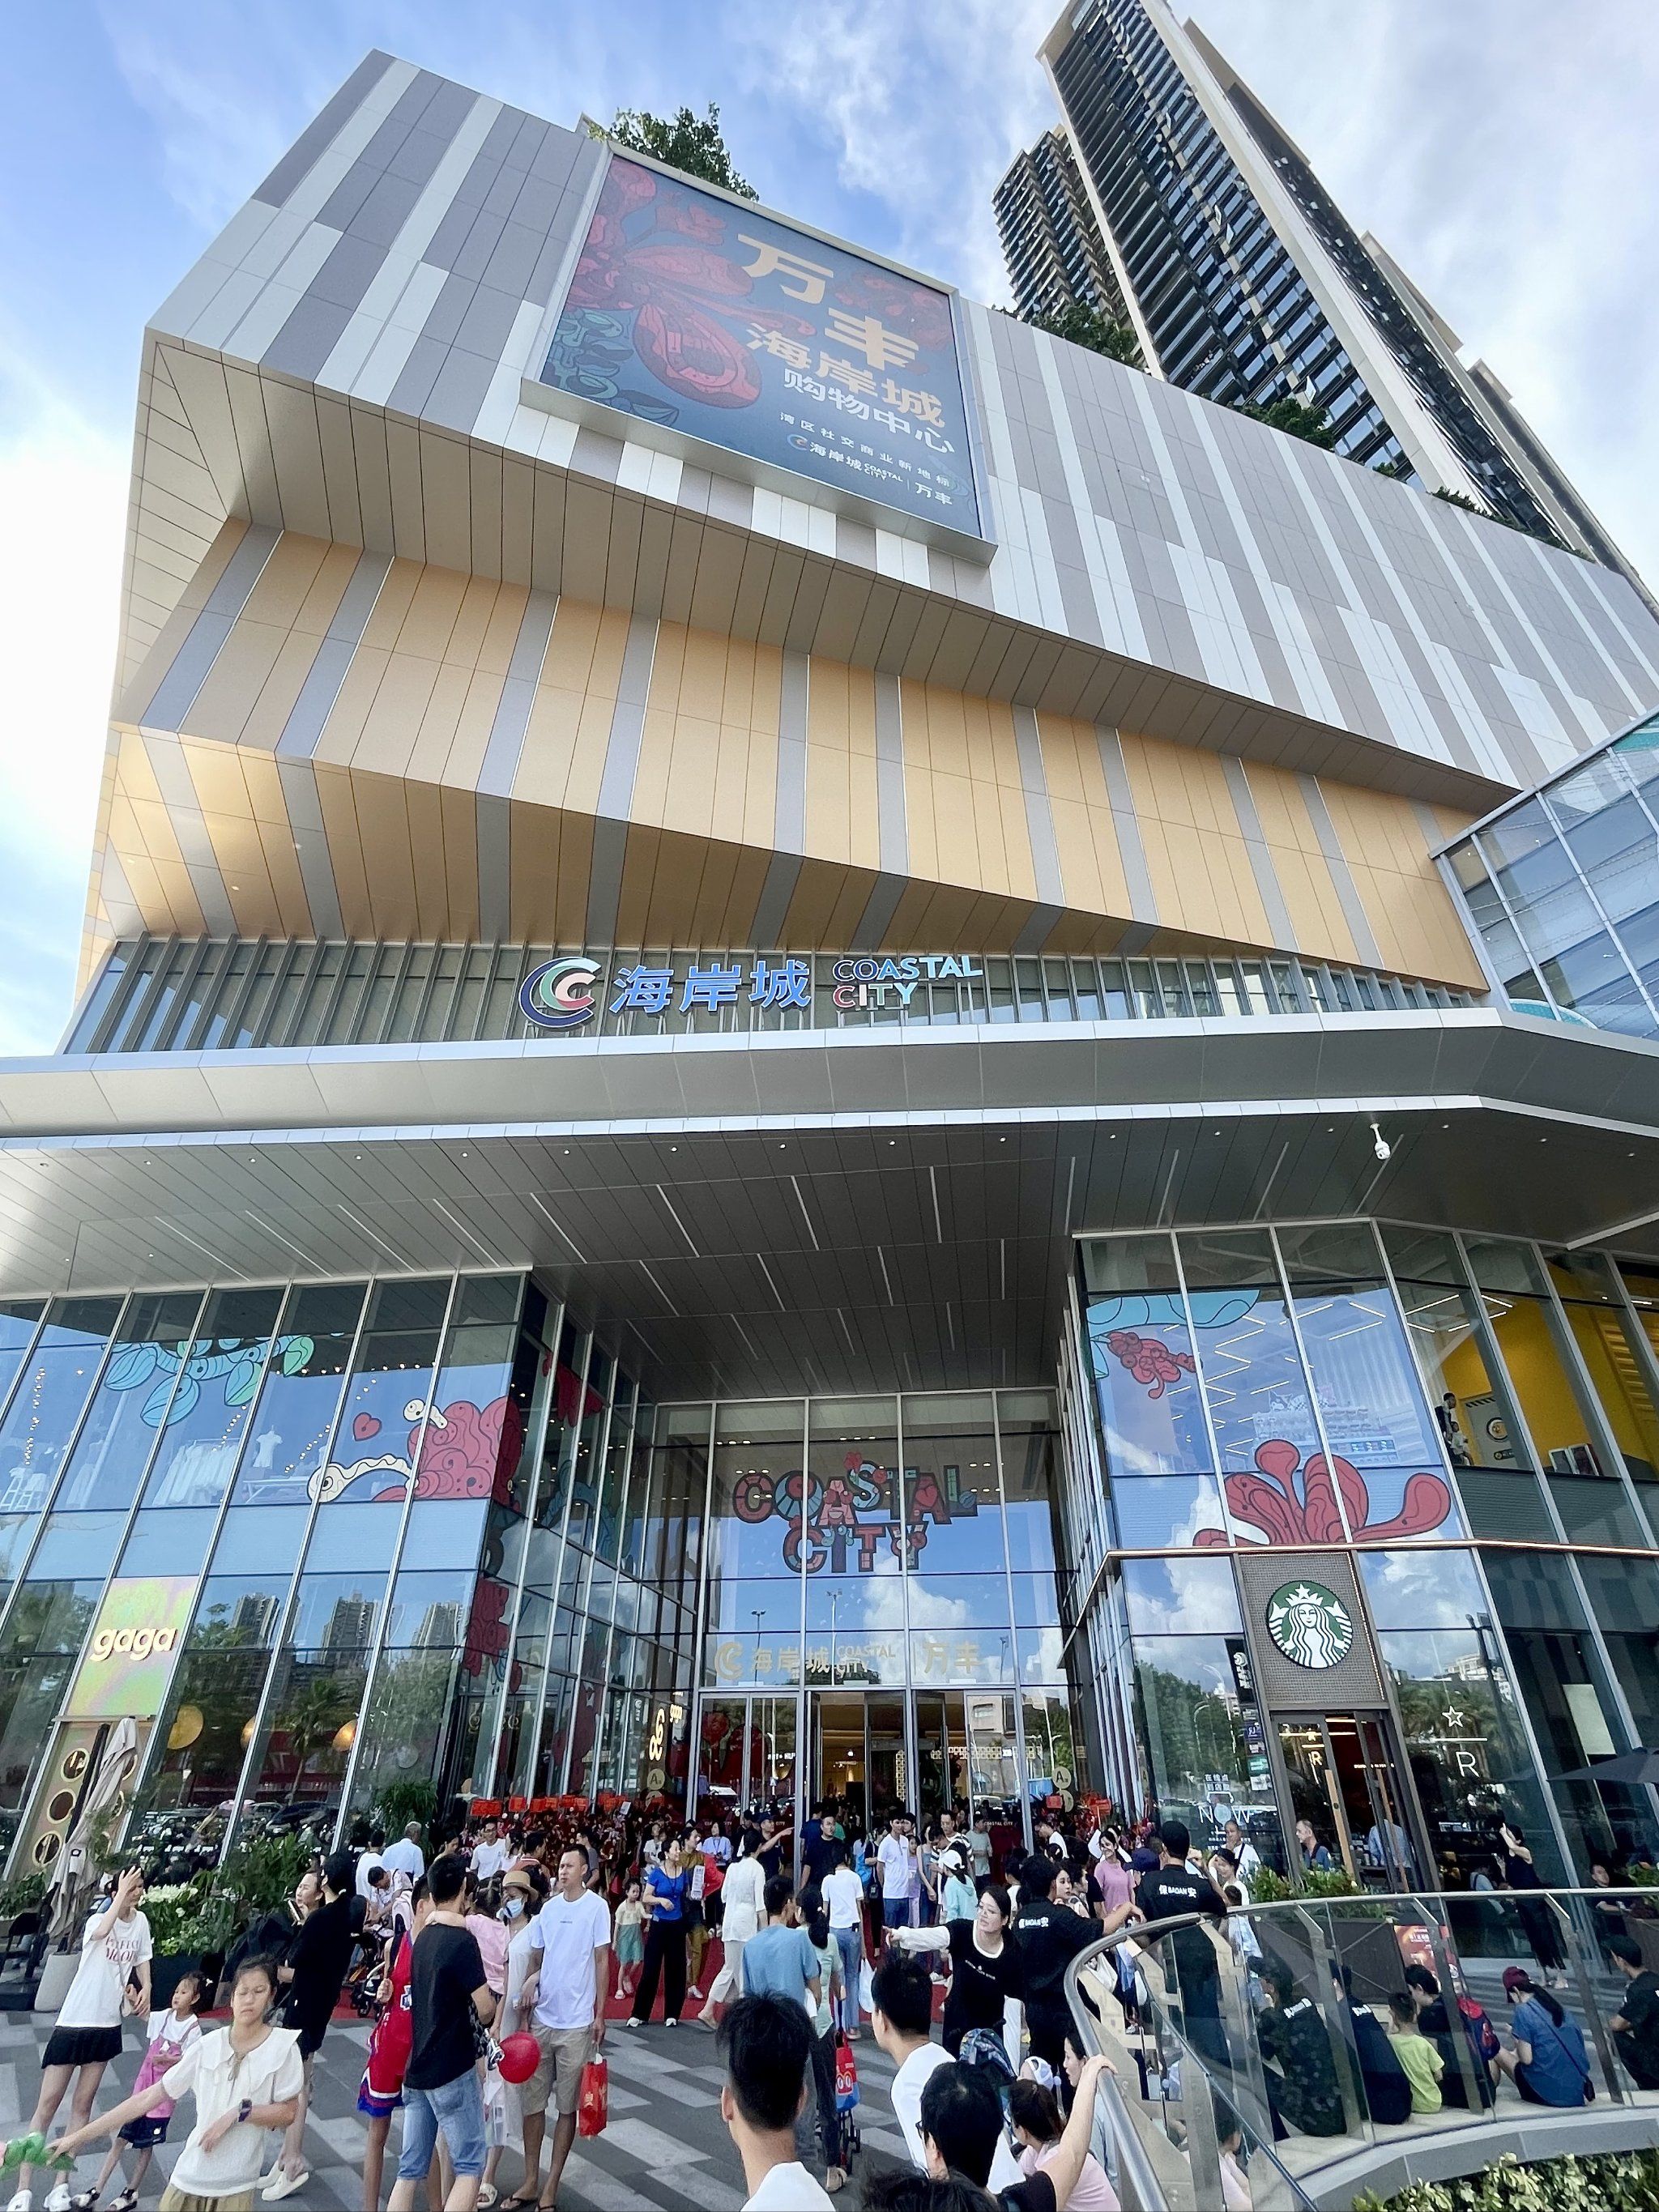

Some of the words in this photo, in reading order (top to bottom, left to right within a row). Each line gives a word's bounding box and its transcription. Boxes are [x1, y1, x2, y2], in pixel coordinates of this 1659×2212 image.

[746, 322, 946, 428] 海岸城
[783, 368, 955, 454] 购物中心
[809, 441, 862, 471] 海岸城
[864, 462, 903, 482] COASTAL
[864, 468, 887, 481] CITY
[915, 481, 953, 505] 万丰
[608, 959, 812, 1014] 海岸城
[832, 955, 983, 982] COASTAL
[832, 982, 917, 1009] CITY
[732, 1460, 979, 1526] COASTAL
[783, 1519, 928, 1574] CITY
[89, 1626, 178, 1662] gaga
[752, 1646, 830, 1674] 海岸城
[836, 1643, 896, 1659] COASTAL
[923, 1641, 983, 1674] 万丰
[1456, 1752, 1479, 1779] R
